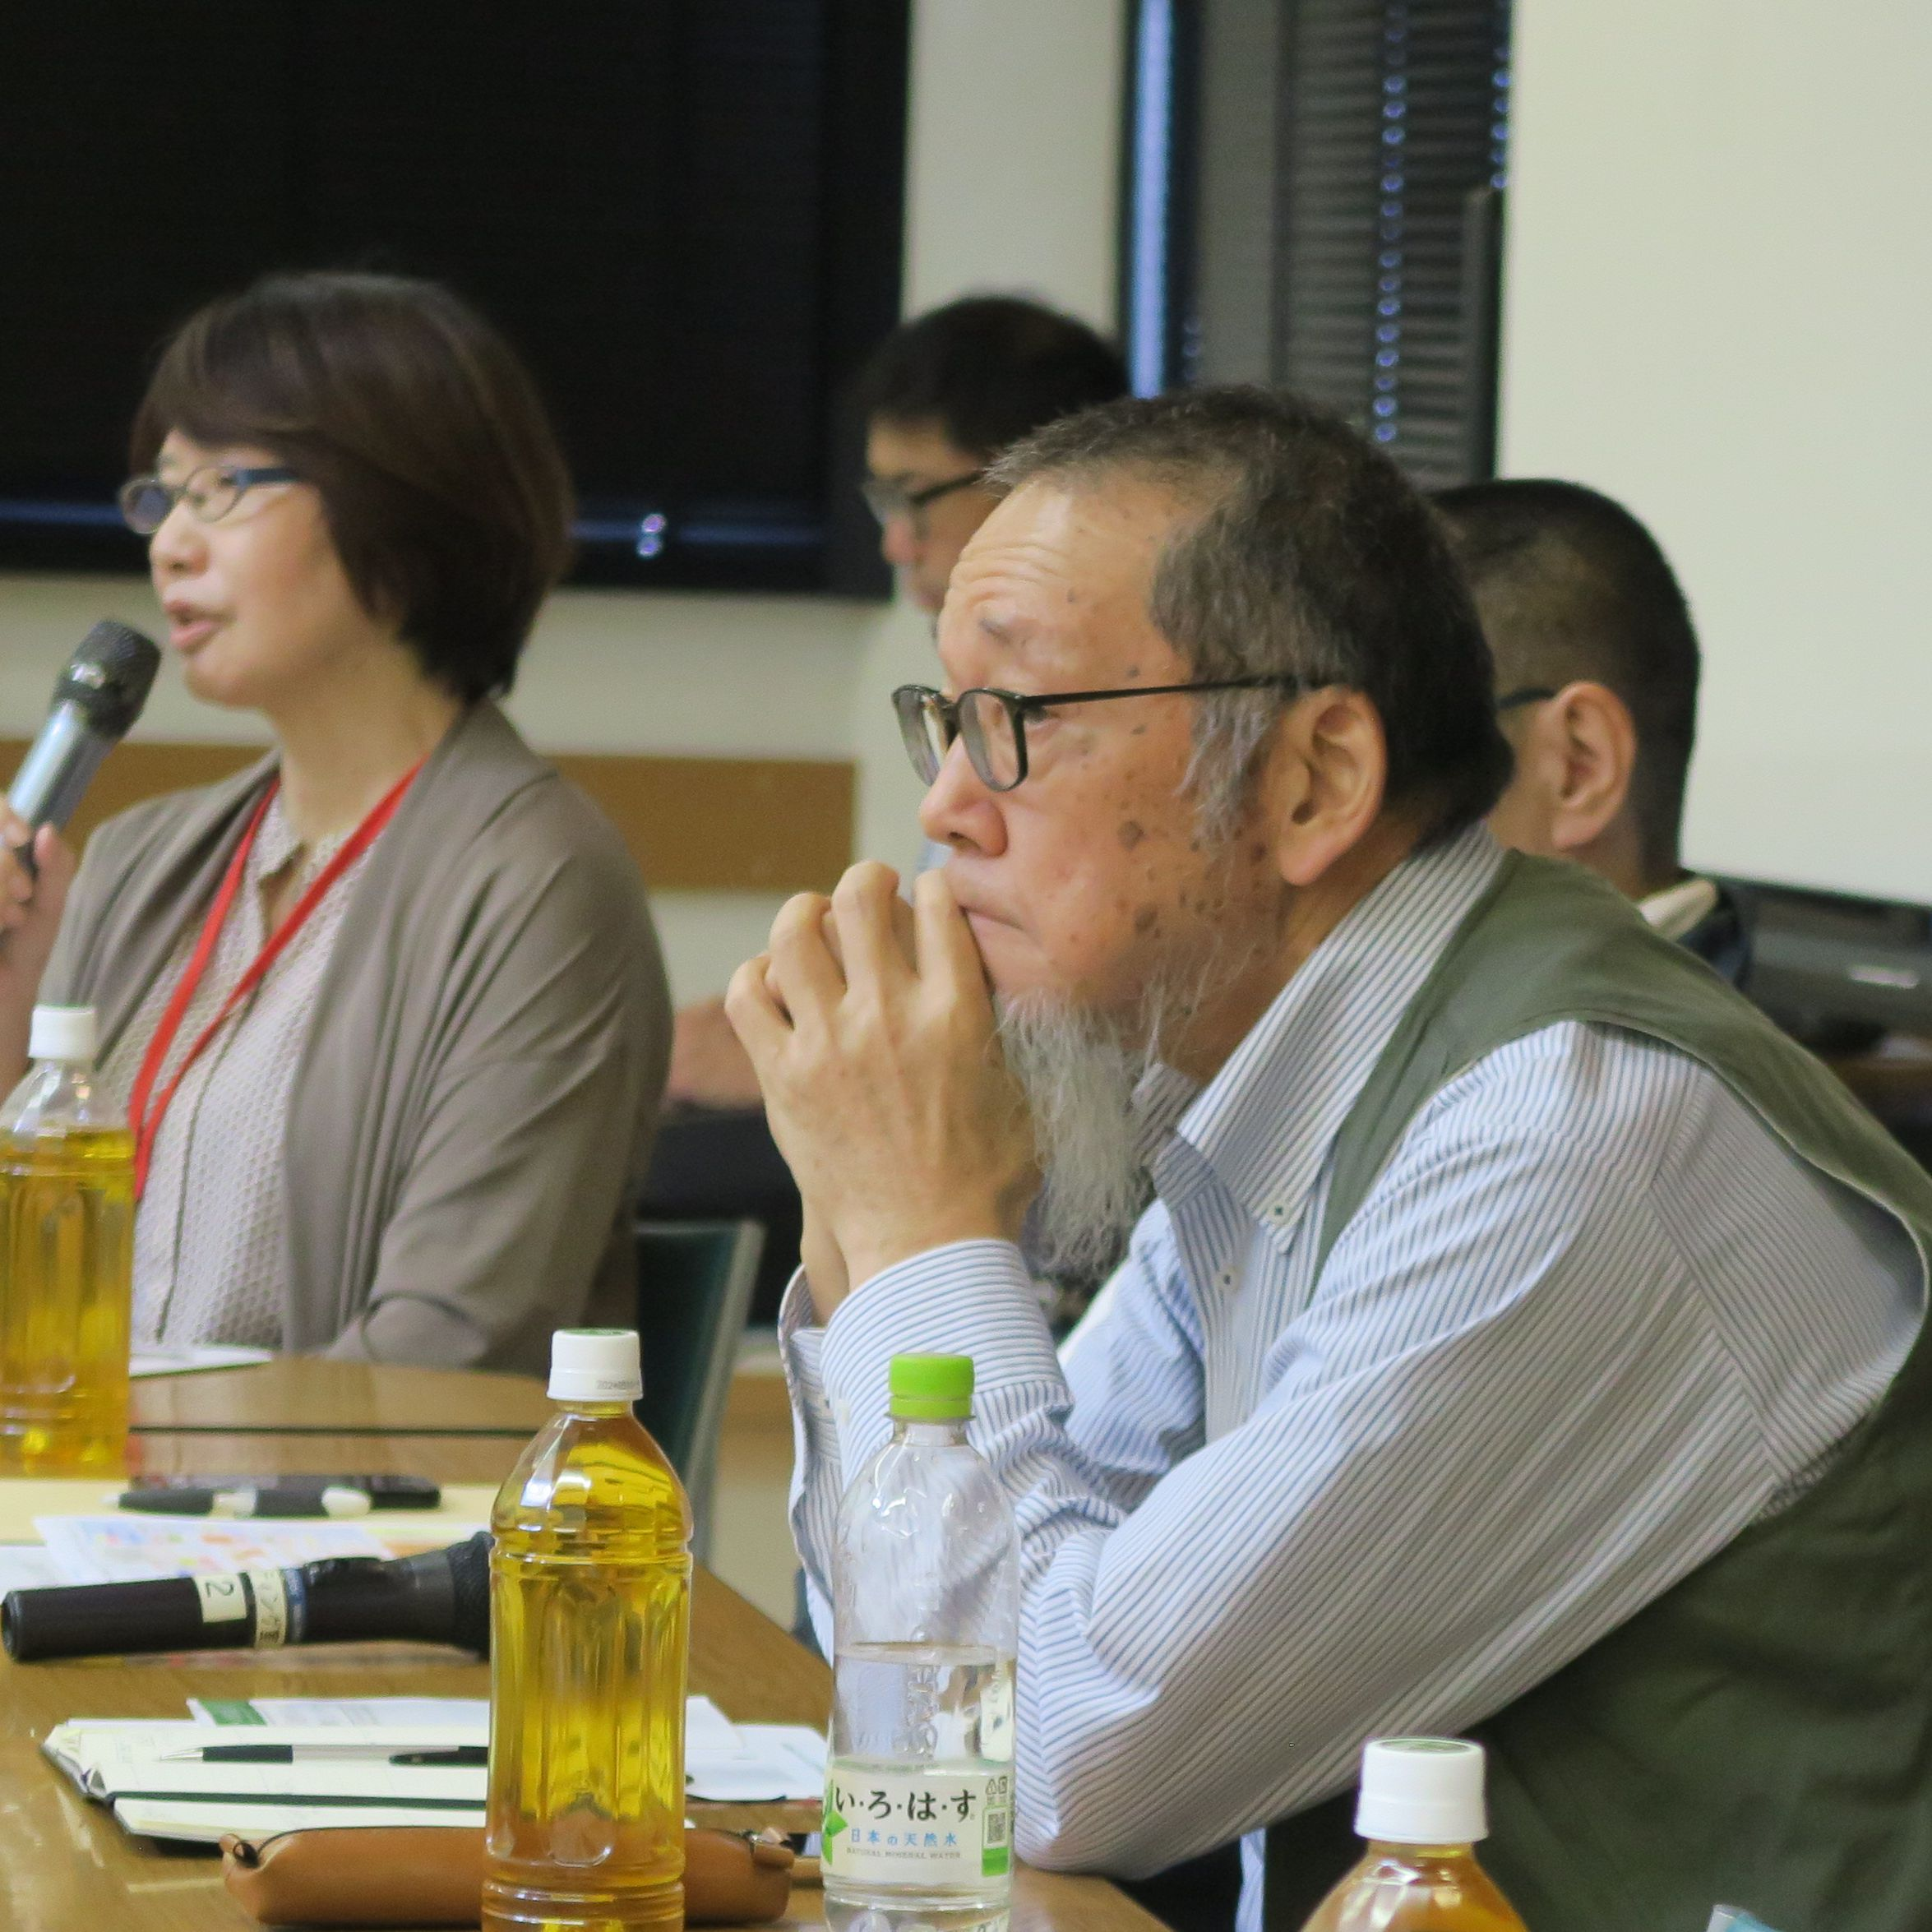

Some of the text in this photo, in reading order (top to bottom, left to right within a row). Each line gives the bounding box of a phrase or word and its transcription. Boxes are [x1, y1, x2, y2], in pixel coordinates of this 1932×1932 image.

[205, 1581, 234, 1598] 2
[850, 1828, 958, 1847] 日本の天然水
